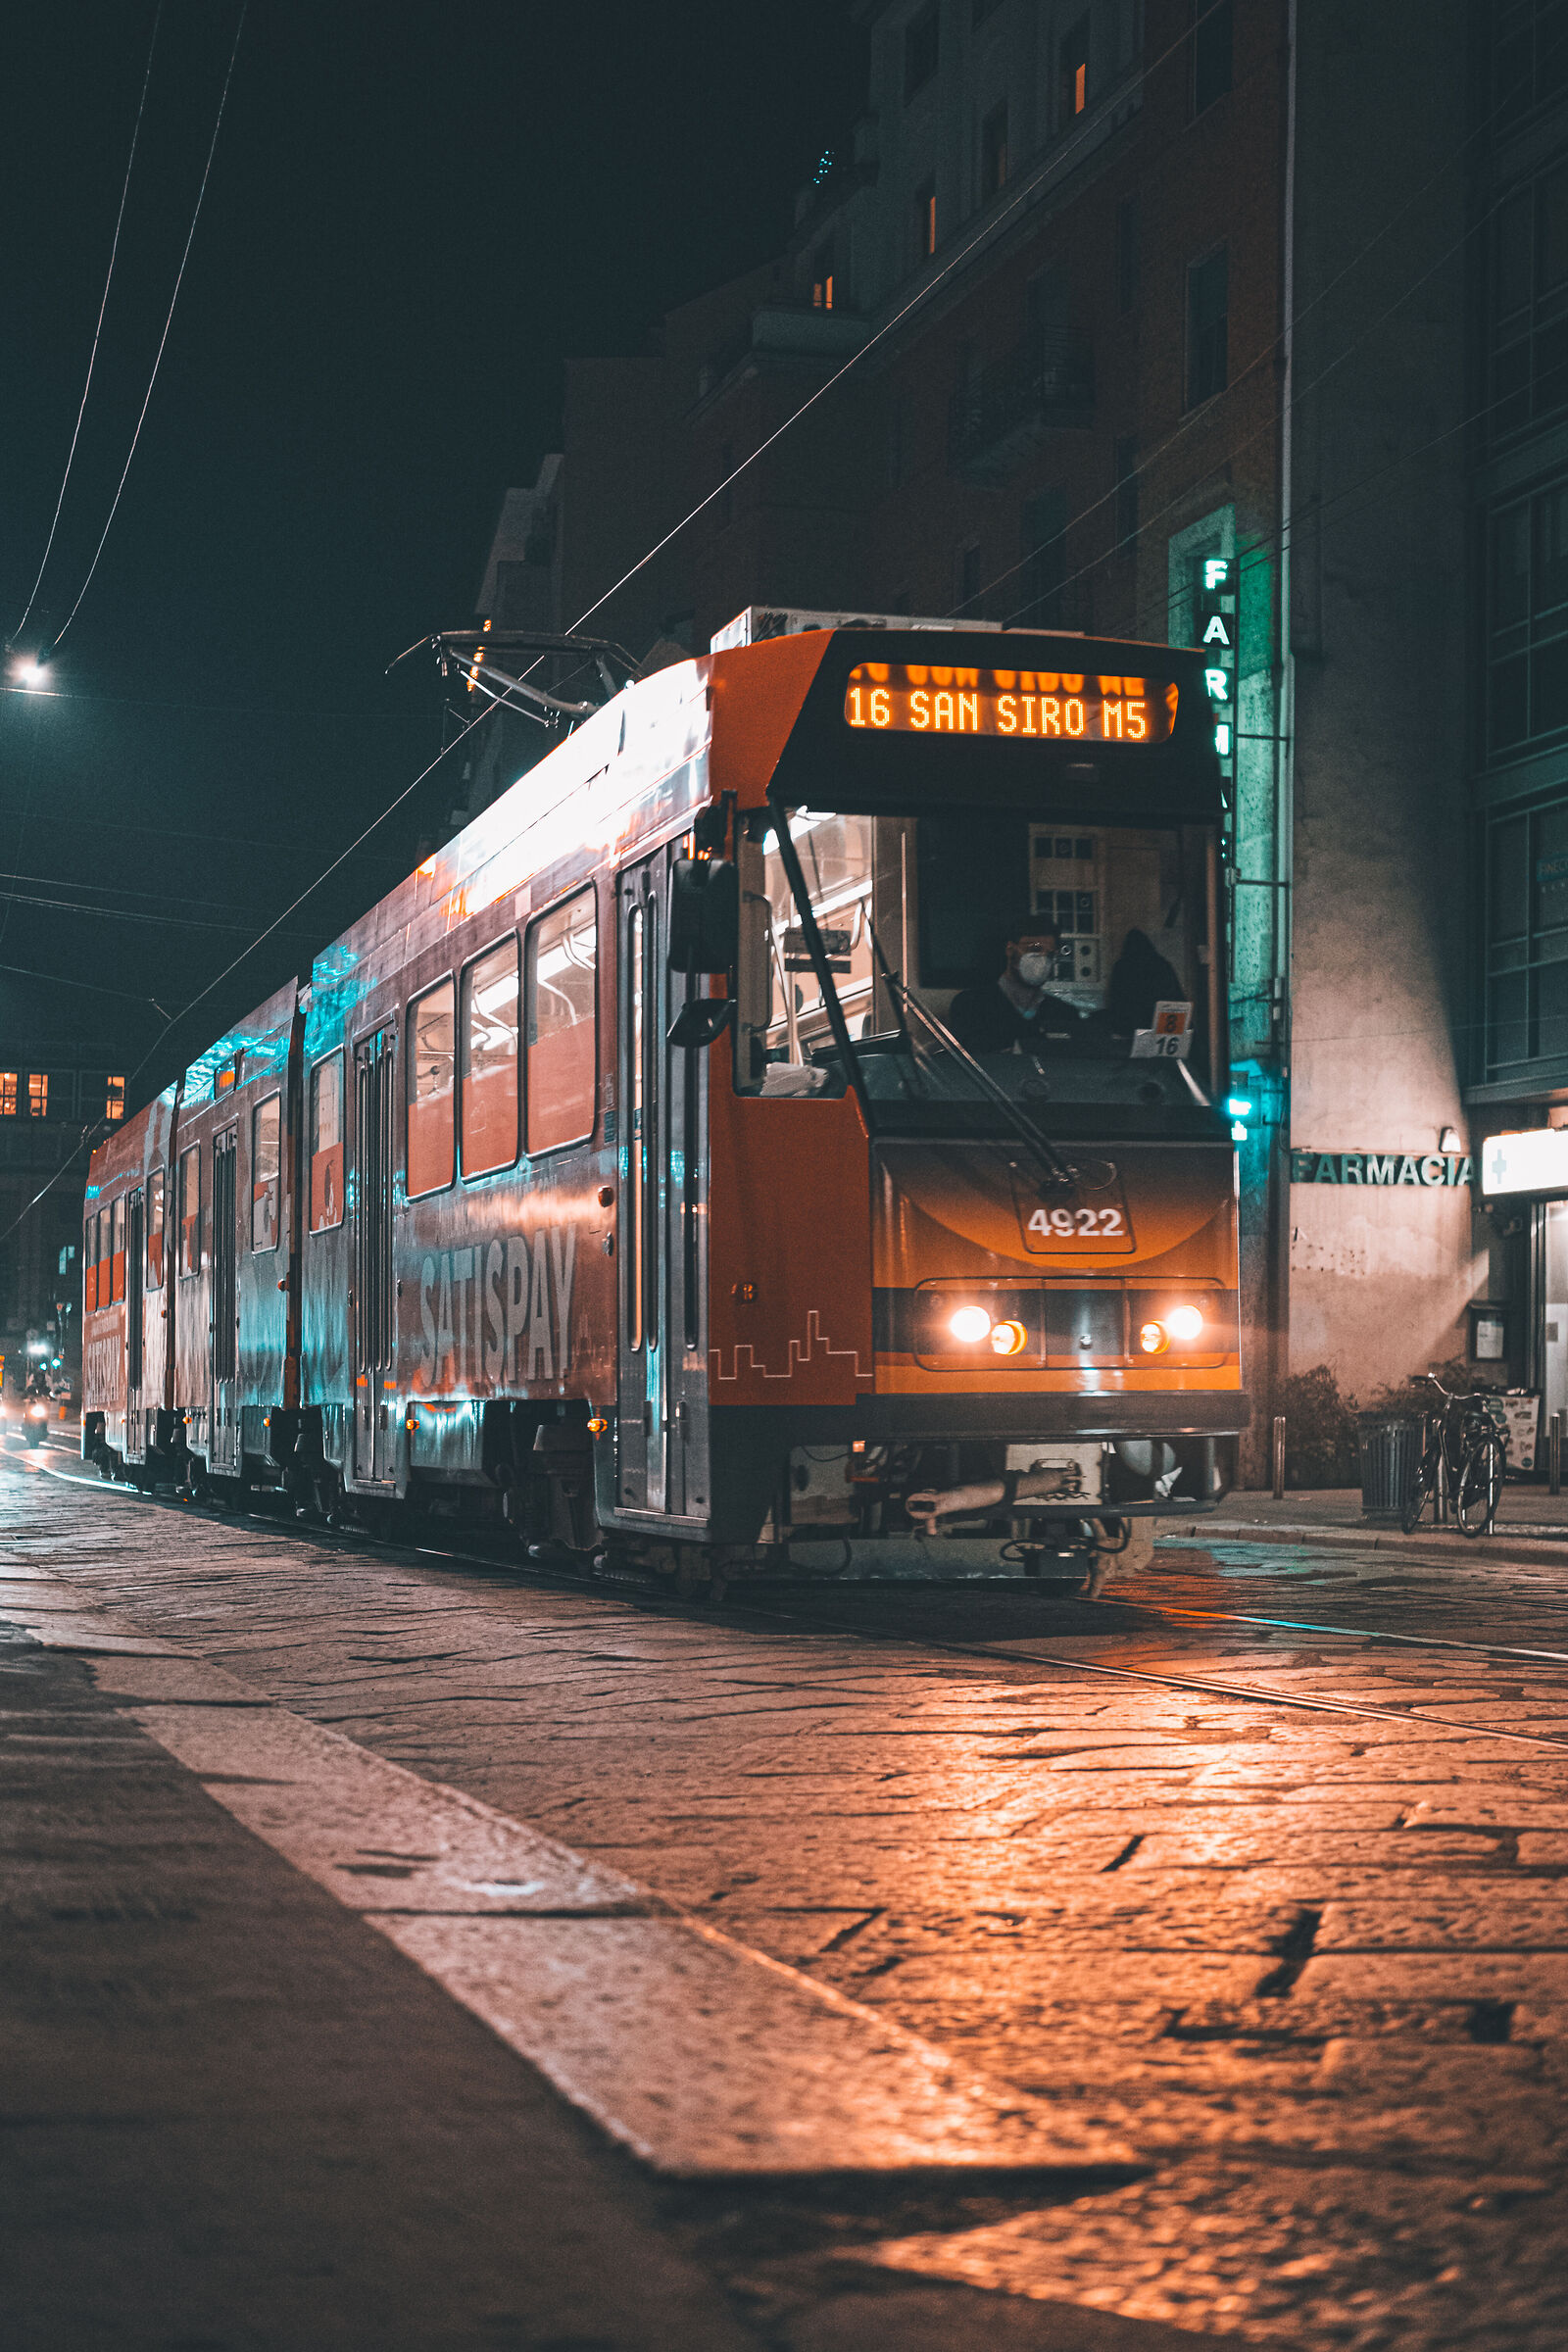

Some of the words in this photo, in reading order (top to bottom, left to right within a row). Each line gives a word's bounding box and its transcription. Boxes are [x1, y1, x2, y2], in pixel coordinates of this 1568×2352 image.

[850, 687, 890, 726] 16
[910, 690, 978, 731] SAN
[998, 695, 1084, 736] SIRO
[1102, 700, 1146, 739] M5
[1155, 1036, 1180, 1055] 16
[1292, 1152, 1474, 1187] FARMACIA
[1028, 1208, 1125, 1238] 4922
[419, 1223, 577, 1389] SATISPAY
